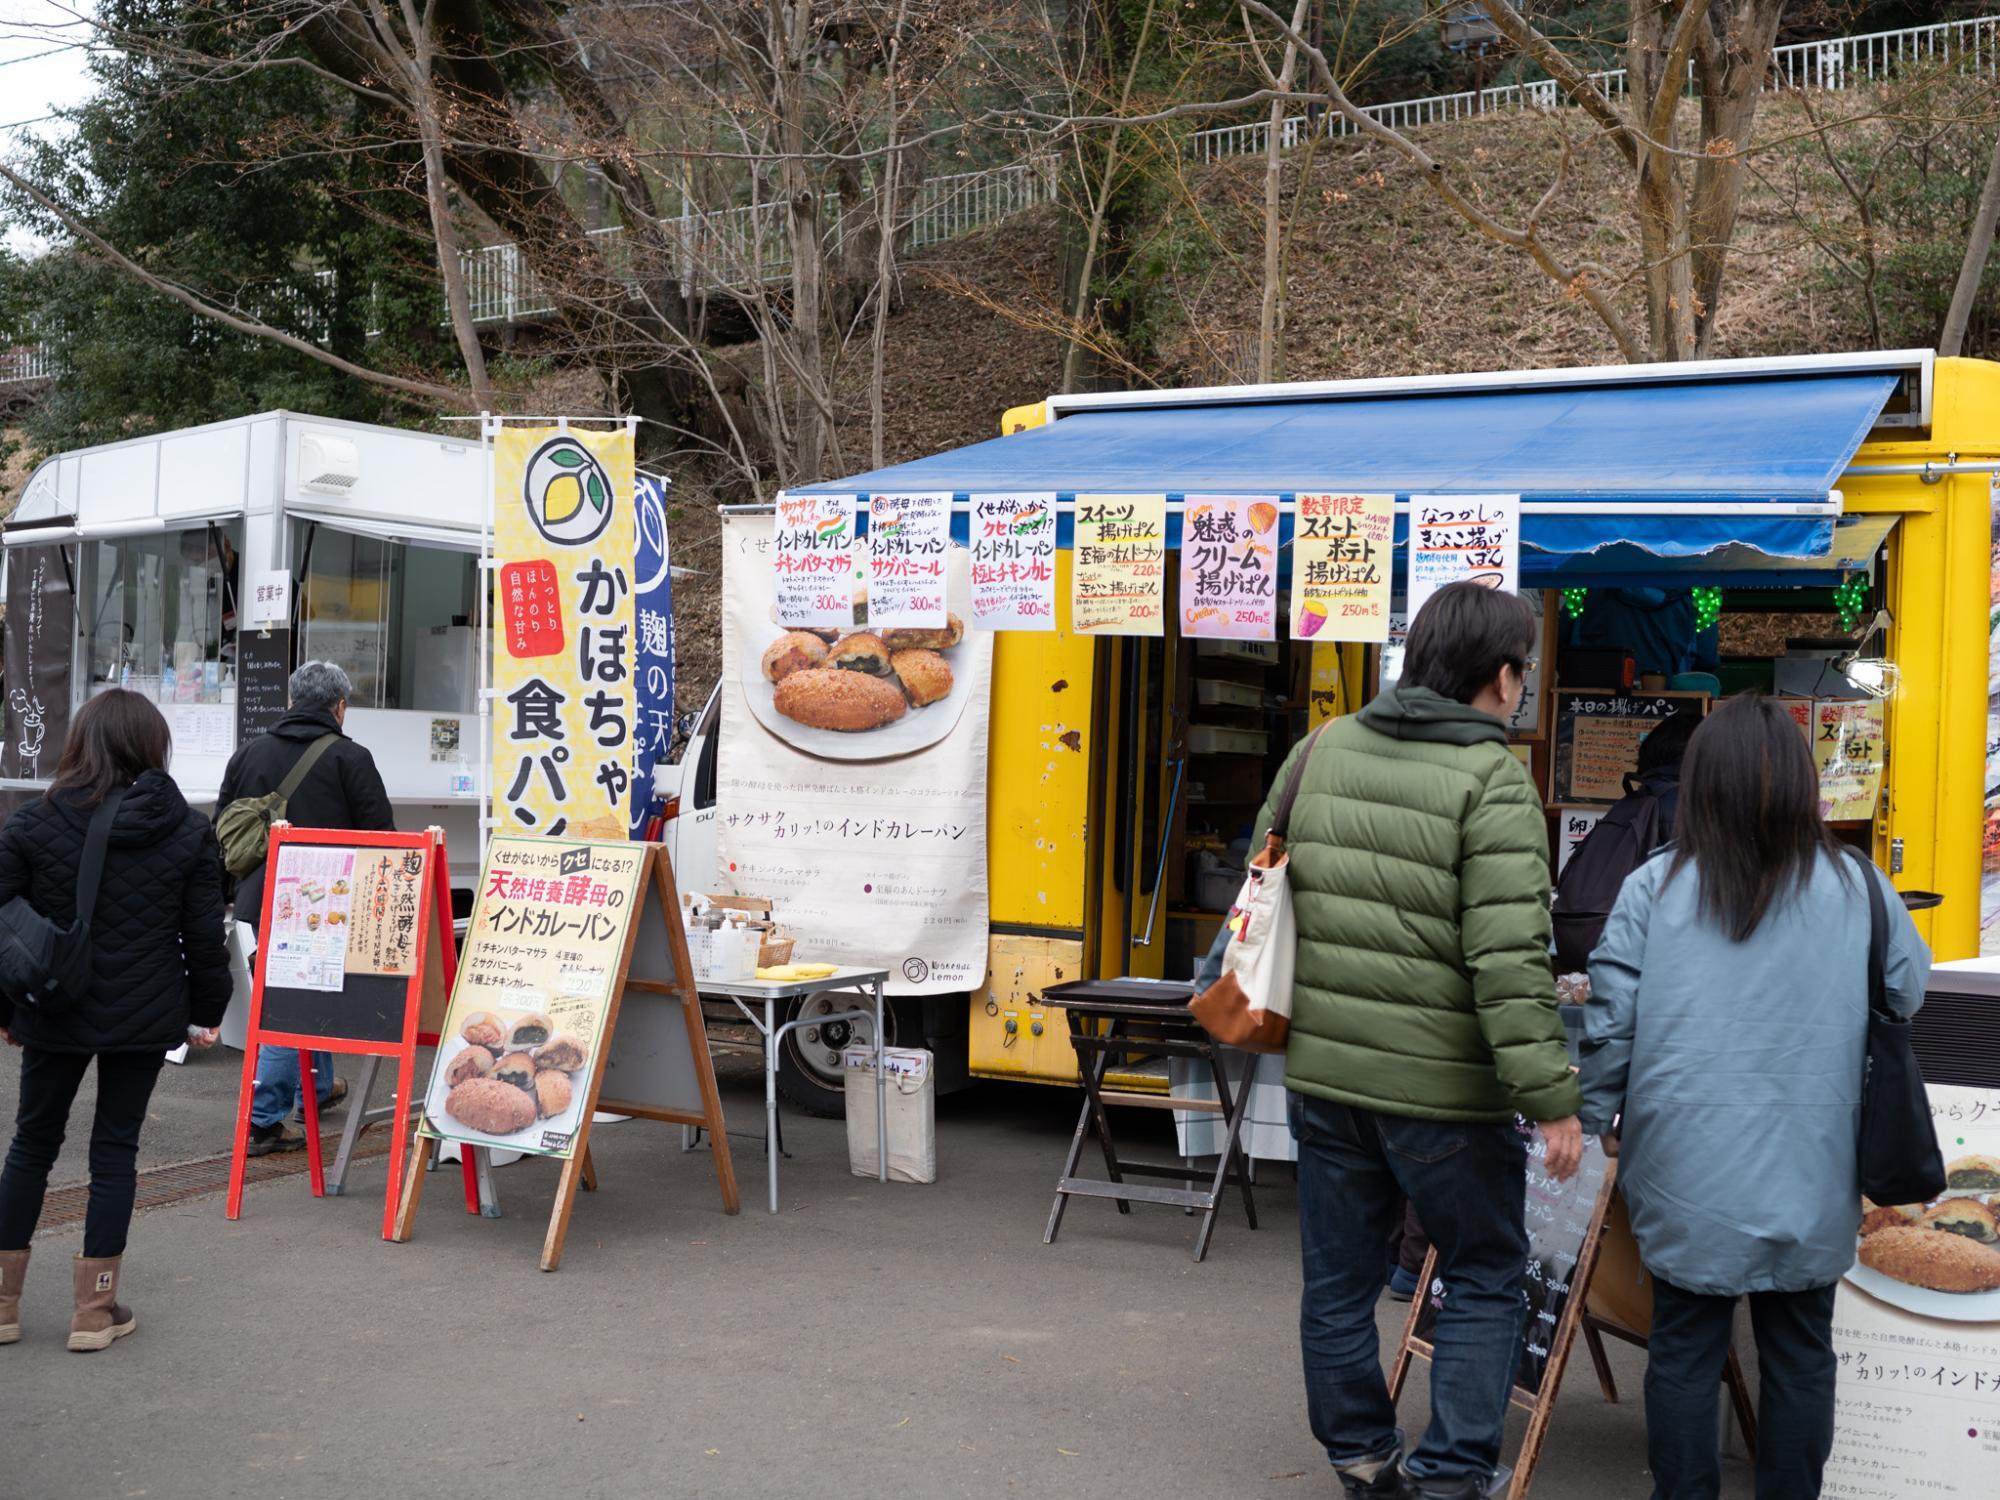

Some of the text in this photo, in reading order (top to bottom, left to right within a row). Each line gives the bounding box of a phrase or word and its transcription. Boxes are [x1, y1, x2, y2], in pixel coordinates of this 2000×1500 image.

[976, 499, 1048, 519] くせがないから
[1077, 504, 1135, 523] スイーツ
[1301, 495, 1366, 516] 数量限定
[1421, 503, 1505, 524] なつかしの
[983, 518, 1054, 539] クセになる!?
[1096, 521, 1160, 542] 揚げぱん
[1188, 511, 1254, 544] 魅惑の
[1299, 516, 1359, 538] スイート
[1419, 526, 1509, 549] きなこ揚げ
[775, 529, 852, 551] インドカレーパン
[870, 537, 946, 556] インドカレーパン
[972, 538, 1054, 562] インドカレーパン
[1326, 537, 1376, 563] ポテト
[775, 552, 852, 574] チキンバターマサラ
[1079, 542, 1163, 565] 至福のあんドーナツ
[1190, 545, 1262, 571] クリーム
[1465, 548, 1505, 568] ぱん
[870, 555, 945, 579] サグパニール
[971, 557, 1054, 584] 極上チキンカレー
[1304, 560, 1381, 585] 揚げぱん
[256, 585, 284, 603] 営業中
[1078, 580, 1159, 598] きなこ揚げぱん
[1195, 568, 1275, 598] 揚げぱん
[510, 570, 527, 651] 自然な甘み
[526, 569, 541, 633] ほんのり
[541, 568, 557, 631] しっとり
[1341, 603, 1369, 617] 250円
[1185, 606, 1221, 625] Cream
[1234, 610, 1264, 623] 250円
[576, 558, 629, 807] かぼちゃ
[1568, 697, 1680, 717] 本日の揚げパン
[485, 869, 625, 908] 天然培養酵母の
[488, 905, 617, 942] インドカレーパン
[931, 972, 965, 982] Lemon
